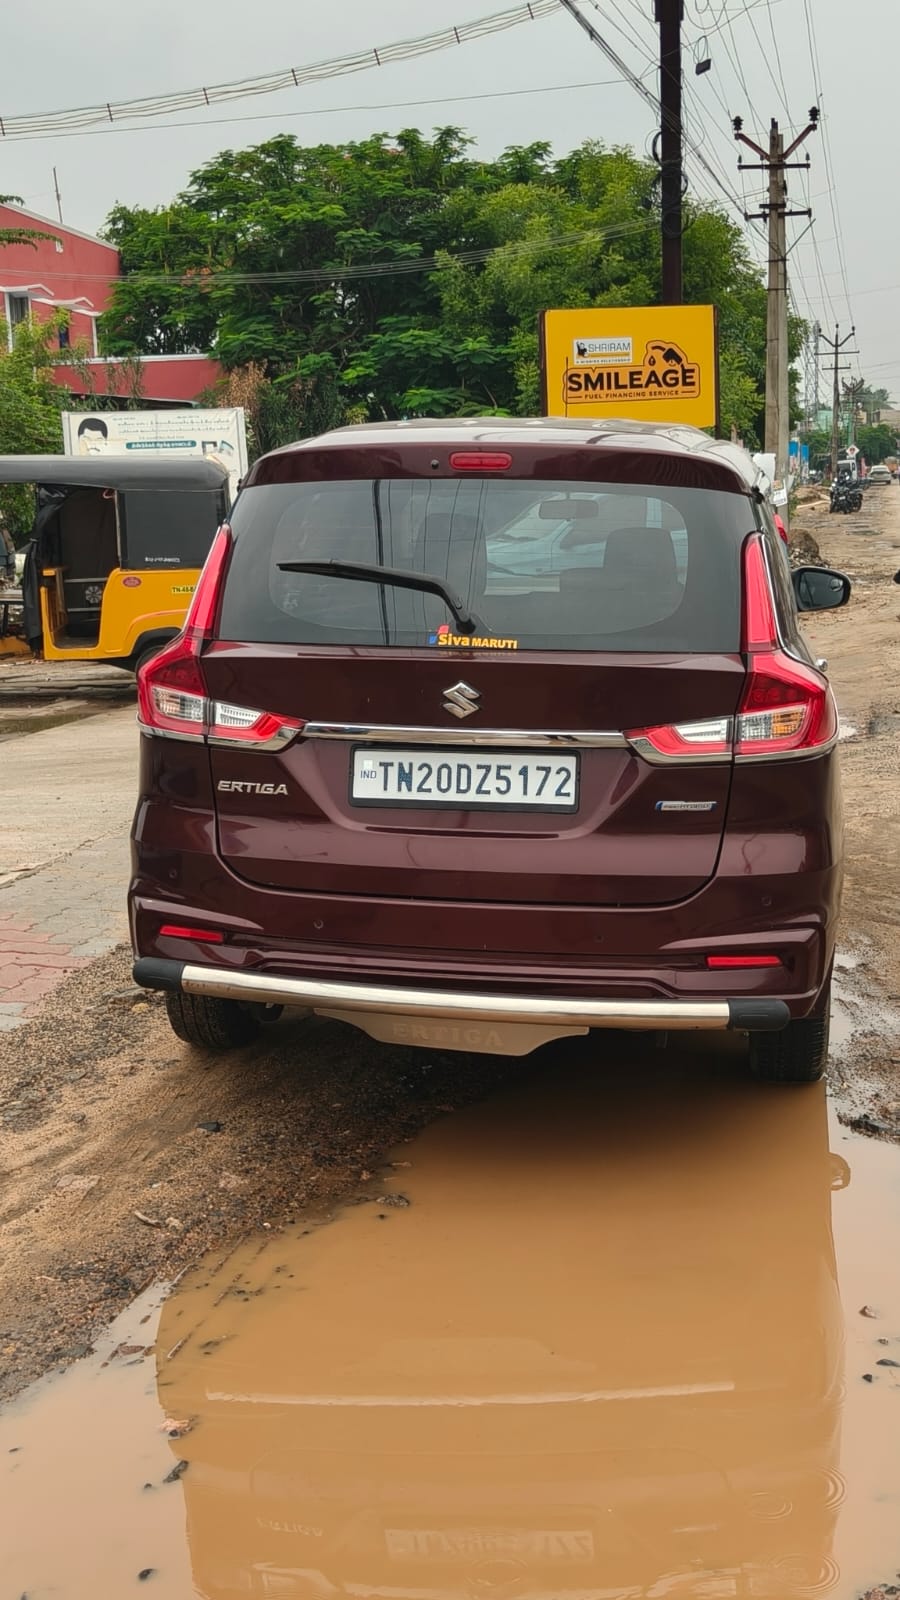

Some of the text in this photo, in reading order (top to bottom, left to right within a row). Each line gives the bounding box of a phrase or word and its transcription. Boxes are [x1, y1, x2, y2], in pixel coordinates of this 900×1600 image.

[588, 343, 631, 353] SHRIRAM
[568, 369, 695, 392] SMILEAGE
[438, 633, 518, 650] Siva MARUTI
[217, 780, 289, 796] ERTIGA
[360, 761, 572, 798] IND TN20DZ5172
[393, 1023, 504, 1046] ERTIGA
